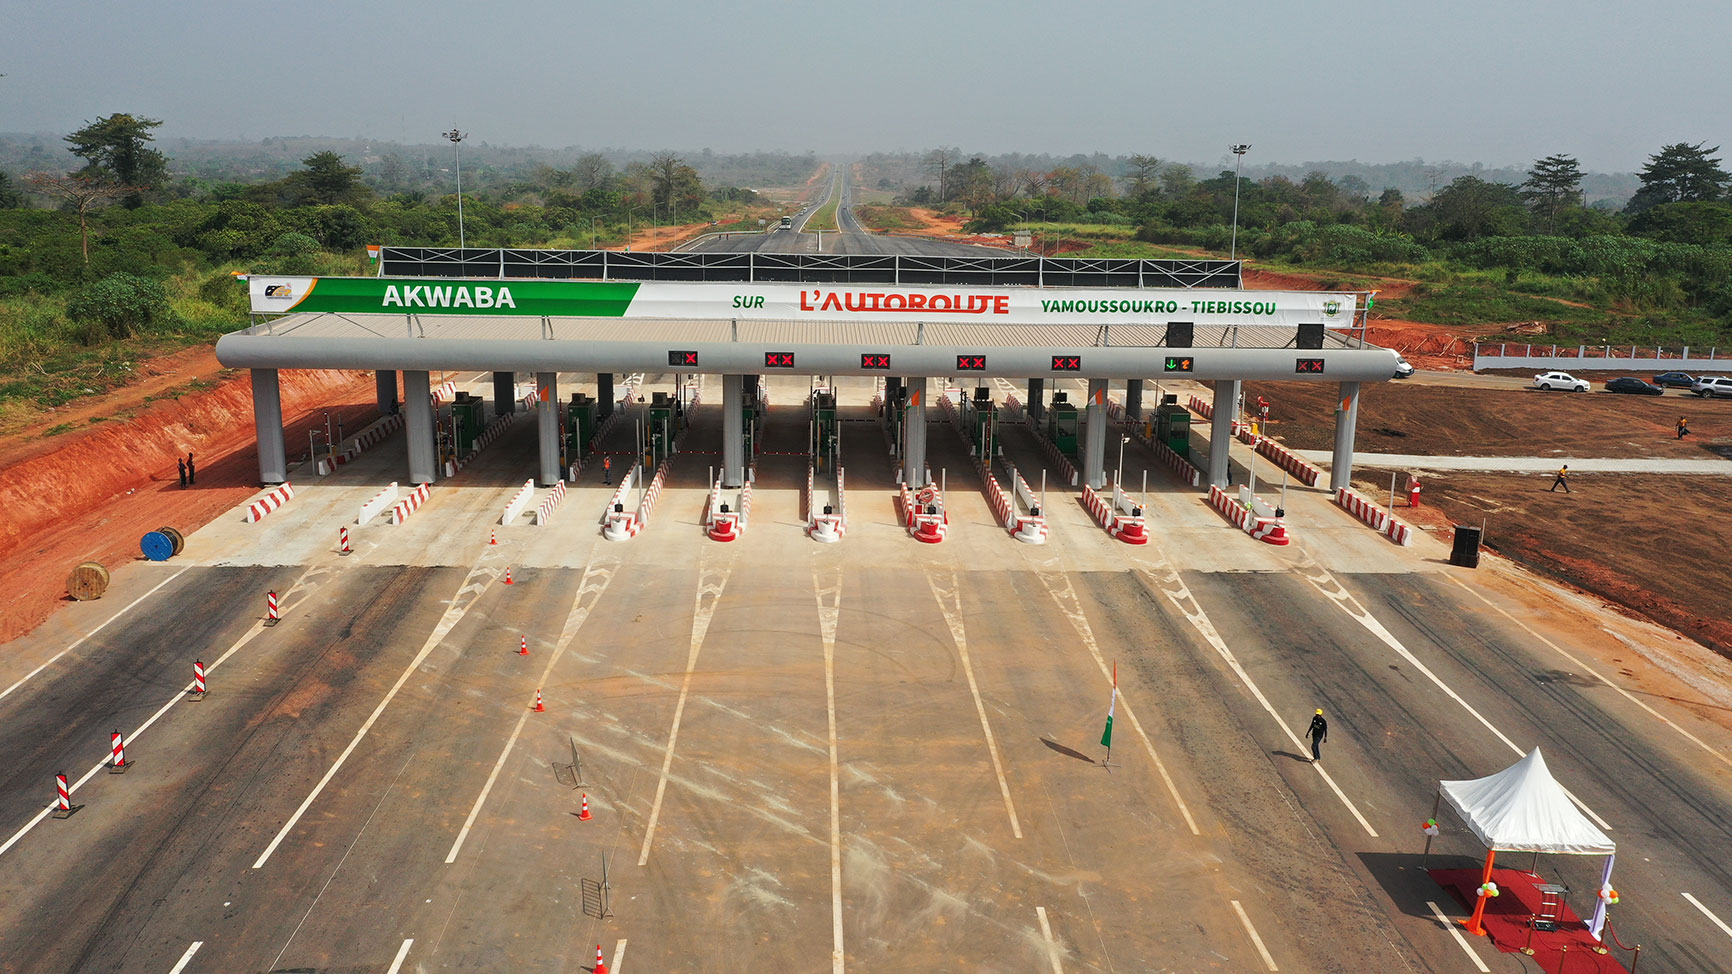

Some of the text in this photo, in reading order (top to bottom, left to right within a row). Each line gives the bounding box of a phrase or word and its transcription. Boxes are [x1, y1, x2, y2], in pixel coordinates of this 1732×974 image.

[382, 285, 516, 309] AKWABA
[732, 295, 765, 309] SUR
[800, 289, 1010, 315] L'AUTOROUTE
[1041, 299, 1178, 314] YAMOUSSOUKRO
[1191, 300, 1277, 316] TIEBISSOU
